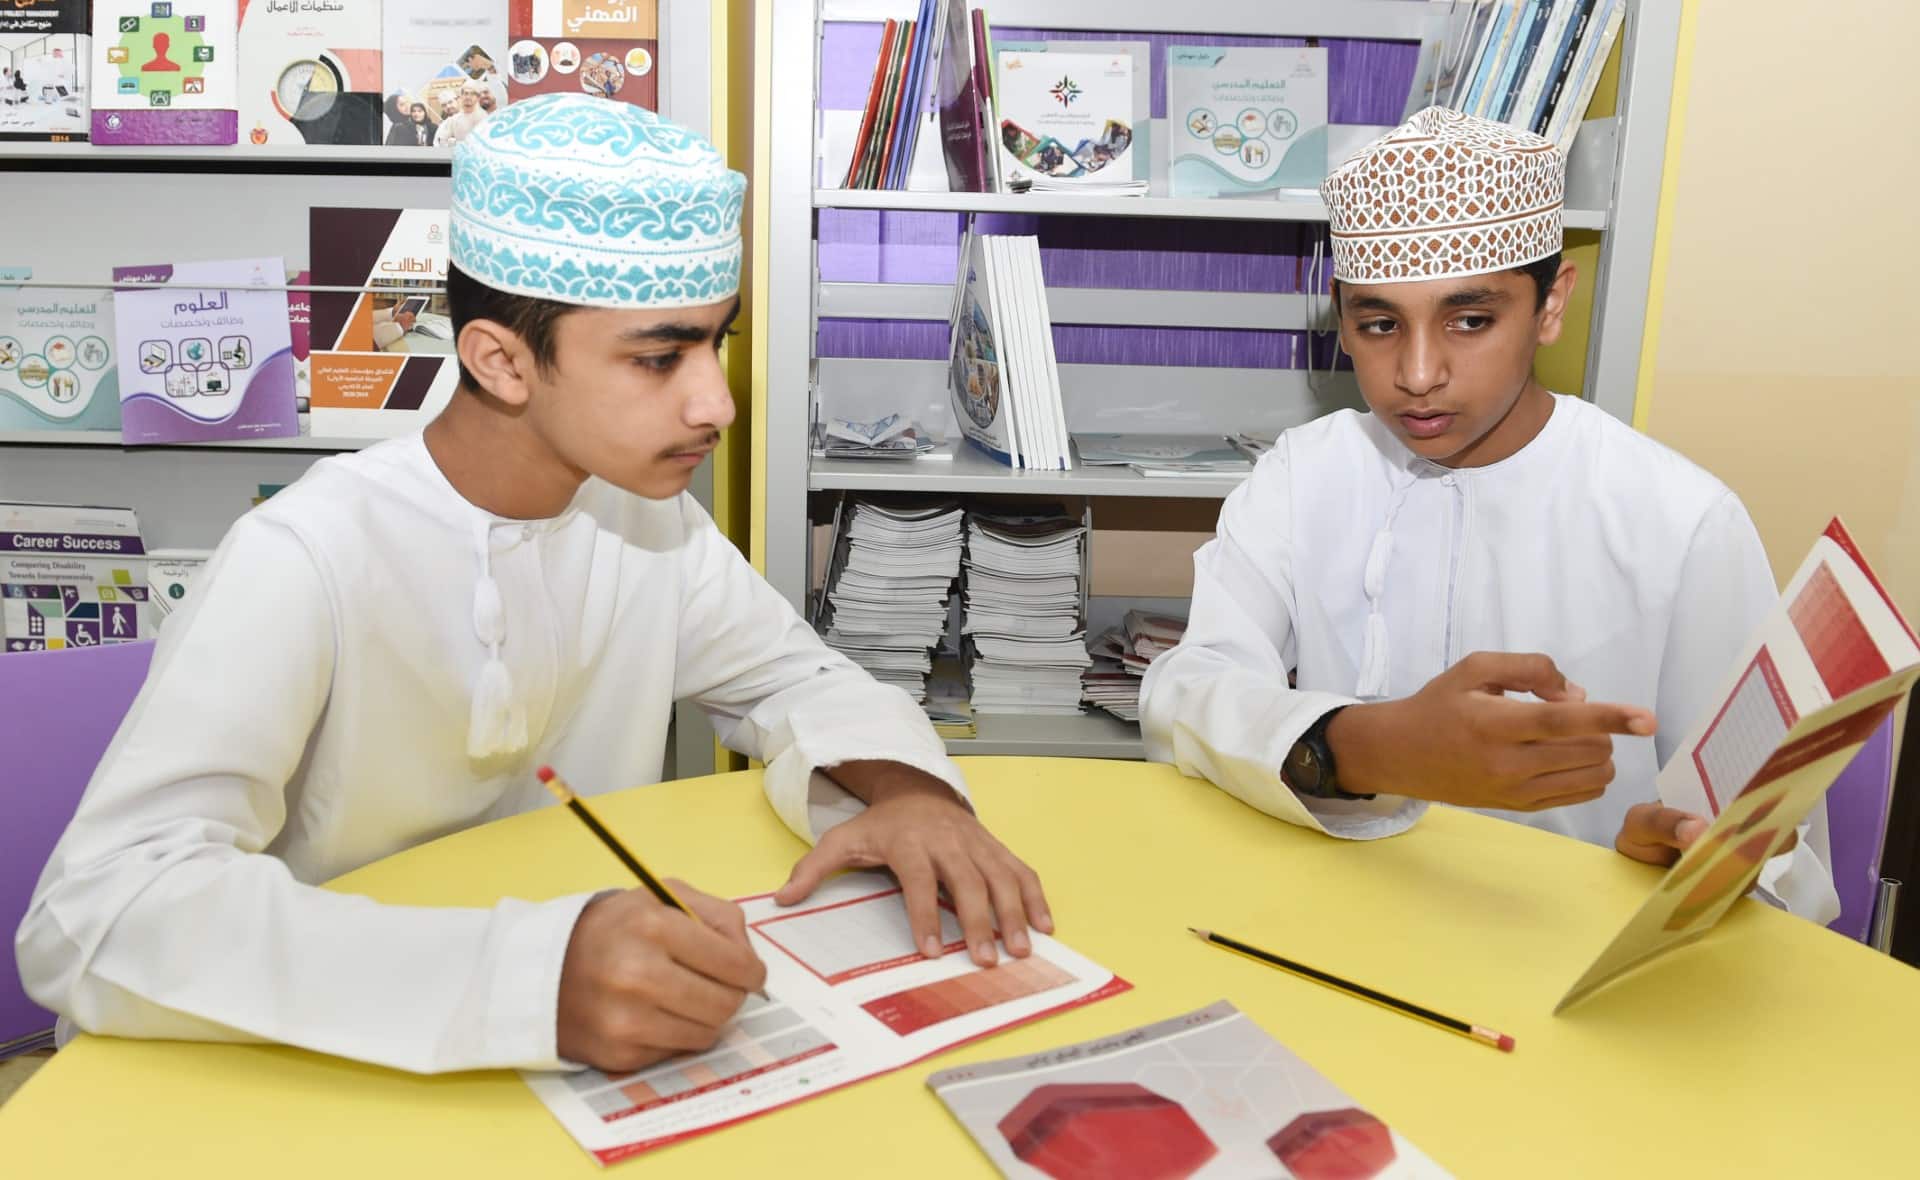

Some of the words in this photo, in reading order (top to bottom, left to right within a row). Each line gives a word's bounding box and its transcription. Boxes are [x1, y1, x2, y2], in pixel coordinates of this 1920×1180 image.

[567, 5, 638, 32] المهني
[381, 257, 432, 277] الطالب
[17, 303, 59, 317] المدرسي
[60, 303, 97, 315] التعليم
[174, 291, 229, 315] العلوم
[12, 534, 59, 548] Career
[62, 535, 121, 550] Success
[53, 561, 85, 571] Disability
